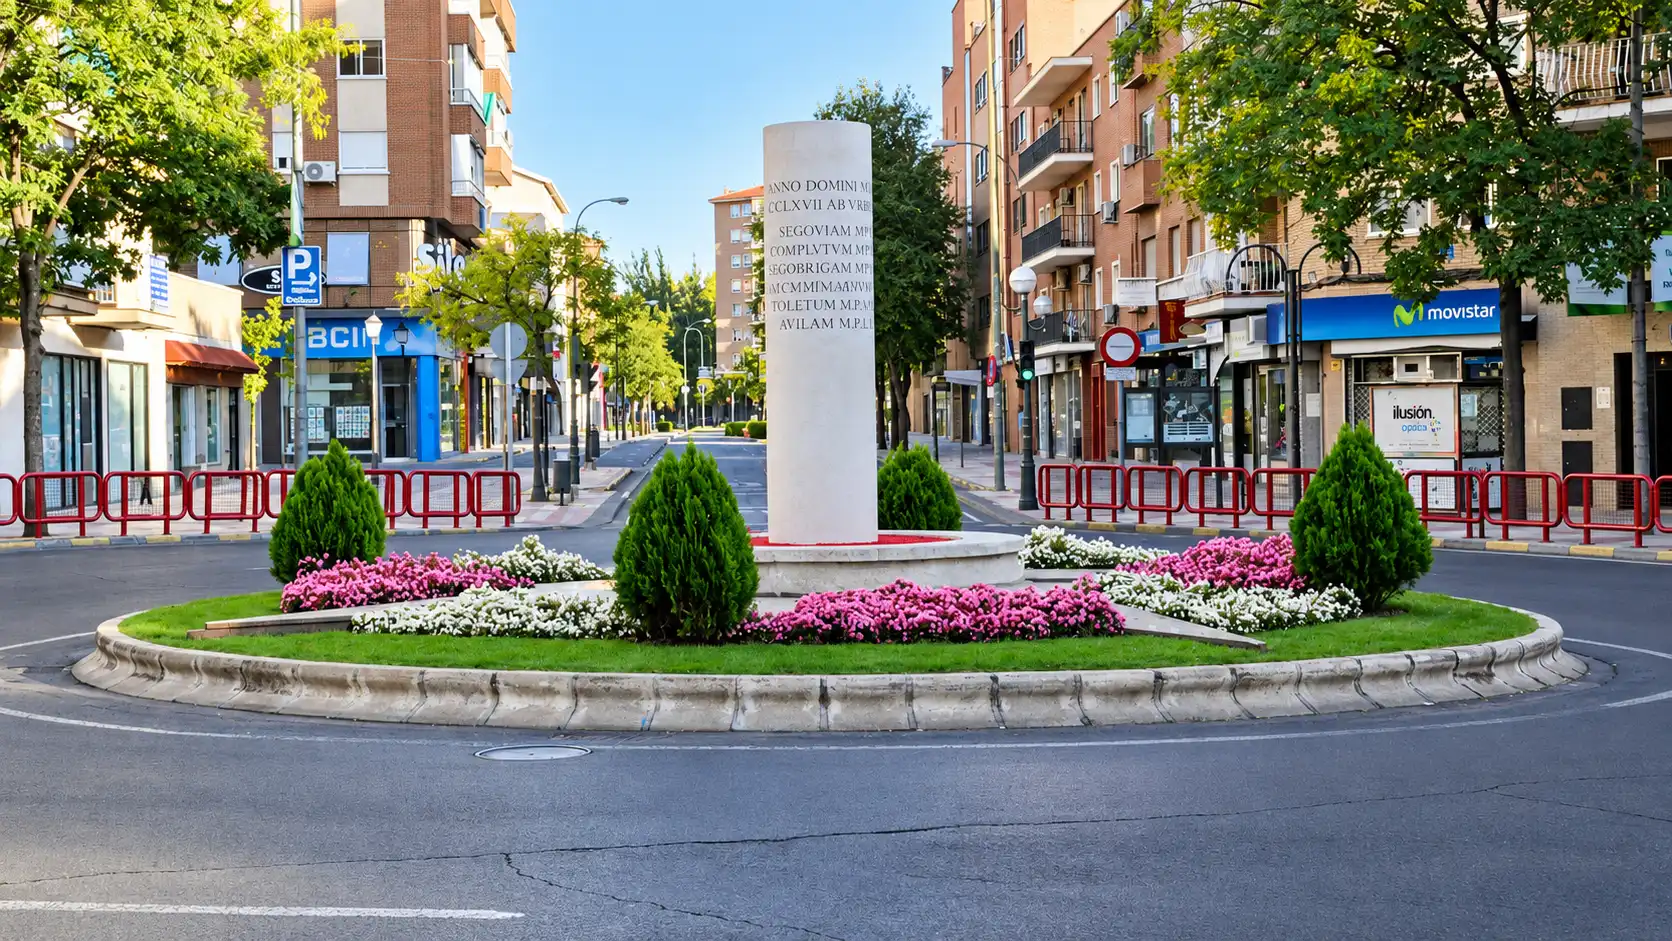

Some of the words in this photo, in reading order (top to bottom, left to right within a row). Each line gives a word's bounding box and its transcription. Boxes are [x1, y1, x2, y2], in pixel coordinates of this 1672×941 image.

[769, 180, 801, 193] ANNO
[806, 179, 857, 192] DOMINI
[768, 199, 821, 214] CCLXVII
[826, 199, 846, 210] AB
[779, 224, 851, 238] SEGOVIAM
[770, 243, 852, 258] COMPLVTVM
[288, 249, 312, 279] P
[769, 262, 852, 275] SEGOBRIGAM
[771, 299, 836, 312] TOLETUM
[1428, 304, 1496, 320] movistar
[780, 318, 834, 330] AVILAM
